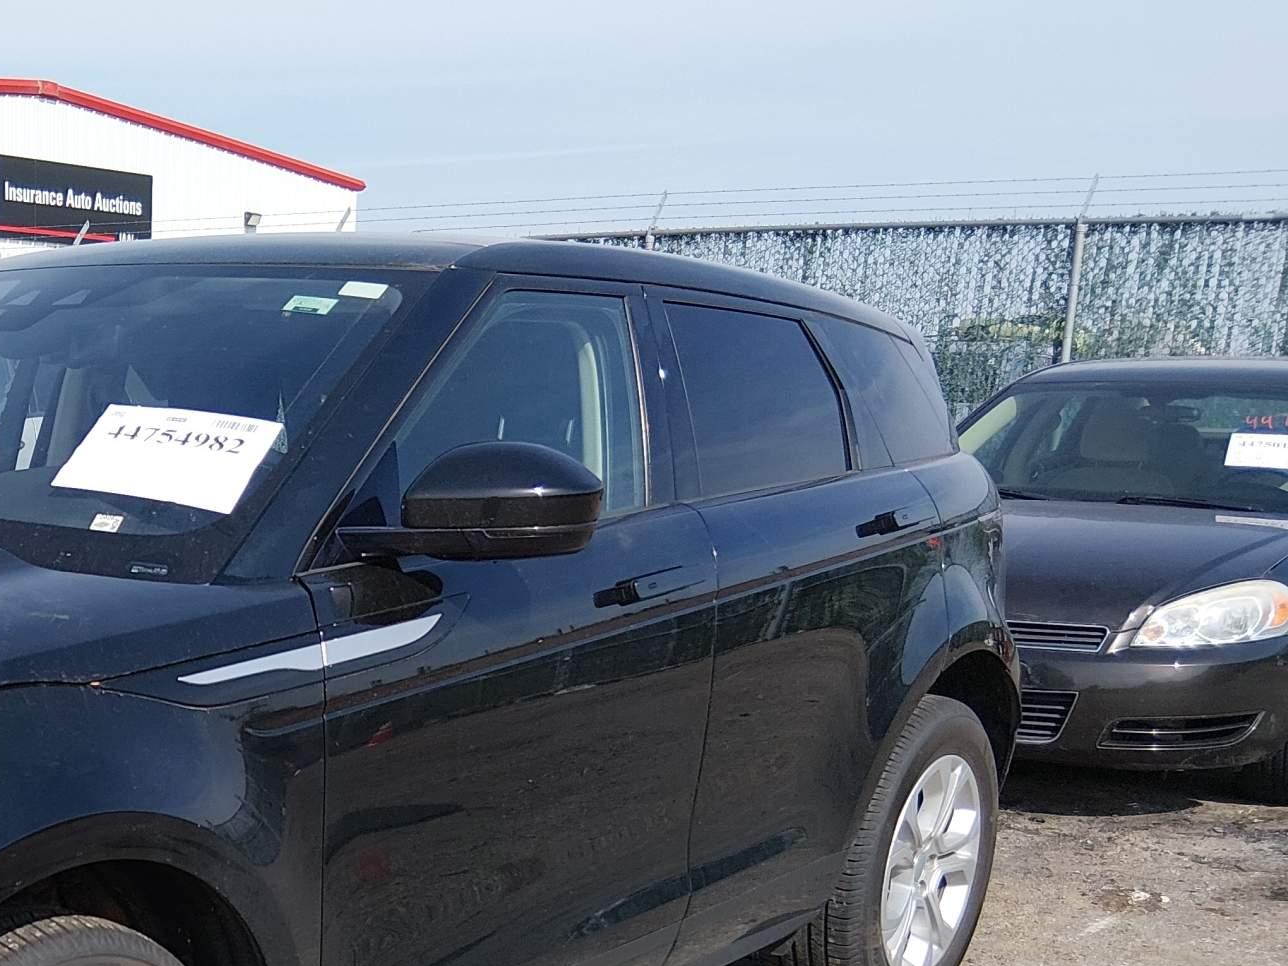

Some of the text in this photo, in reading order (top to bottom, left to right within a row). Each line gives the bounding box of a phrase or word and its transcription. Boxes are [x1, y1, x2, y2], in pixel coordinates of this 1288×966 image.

[4, 180, 143, 216] Insurance Auto Auctions
[108, 424, 245, 455] 44754982
